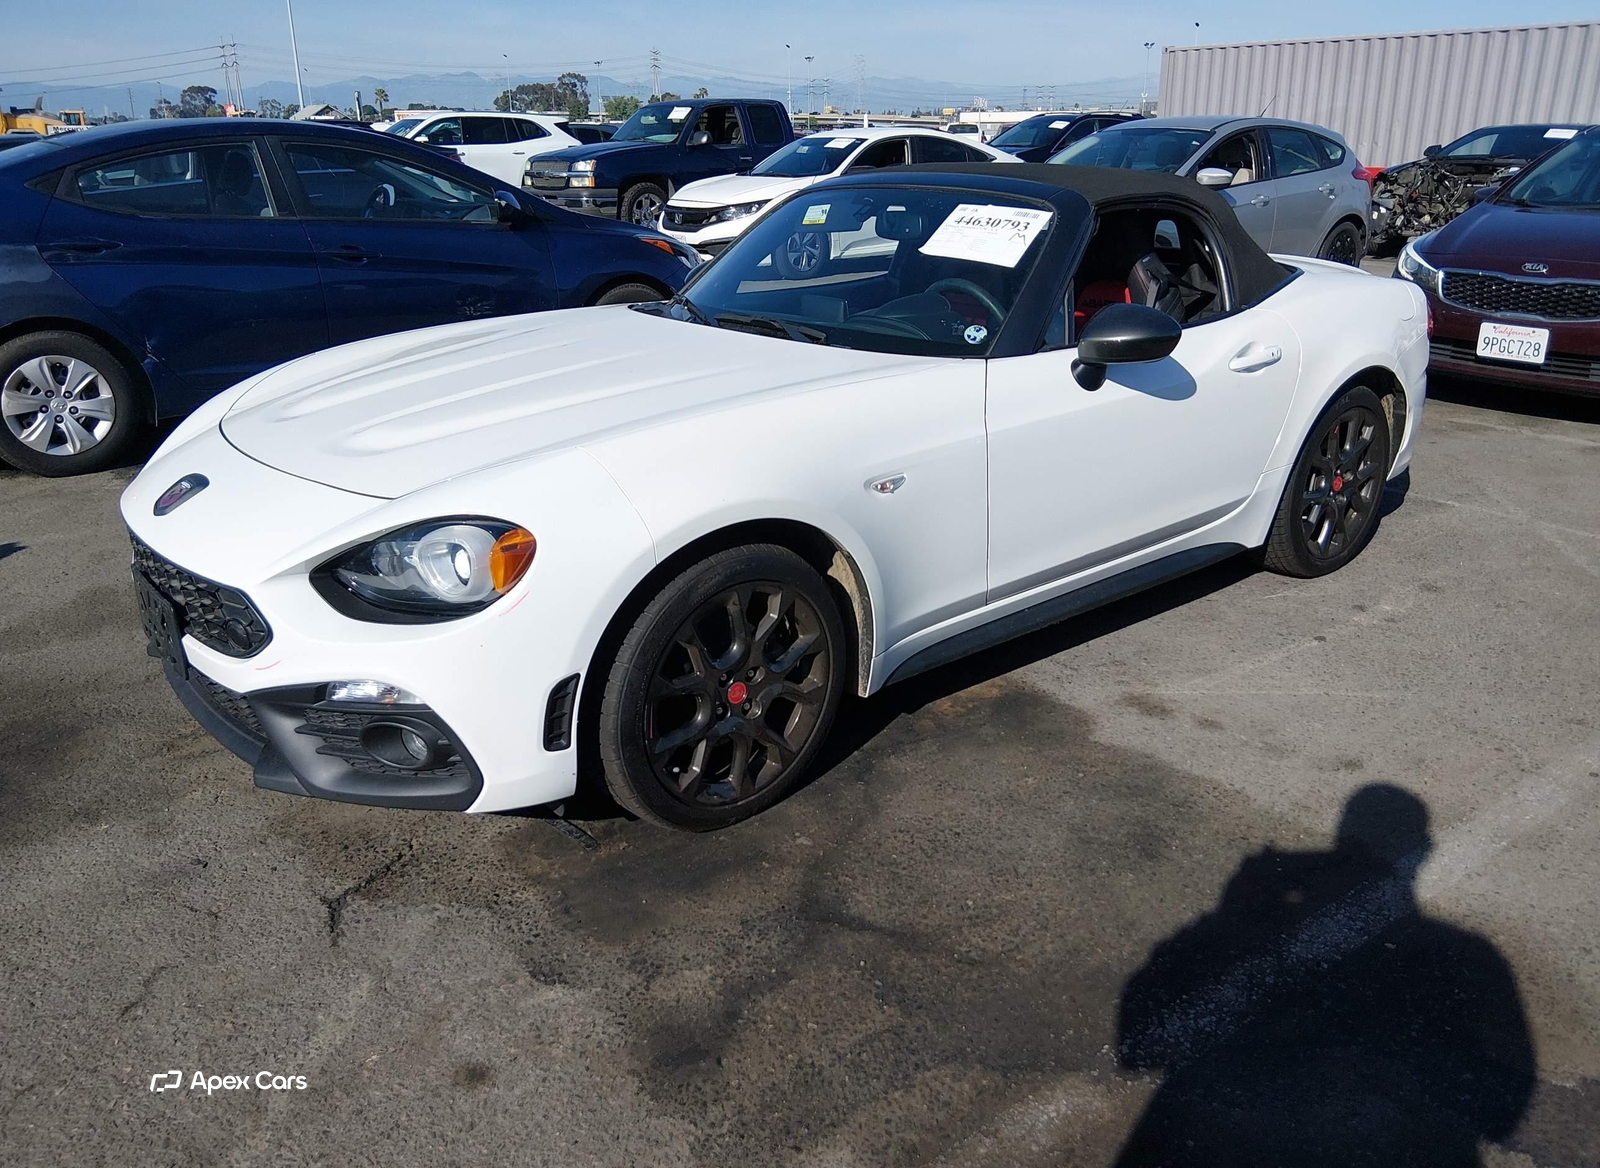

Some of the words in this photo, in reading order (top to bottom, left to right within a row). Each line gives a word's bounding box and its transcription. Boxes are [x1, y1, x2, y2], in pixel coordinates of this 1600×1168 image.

[954, 215, 1031, 232] 44630793
[1525, 262, 1545, 271] KIA
[1493, 325, 1533, 338] California
[1481, 336, 1542, 358] 9PGC728
